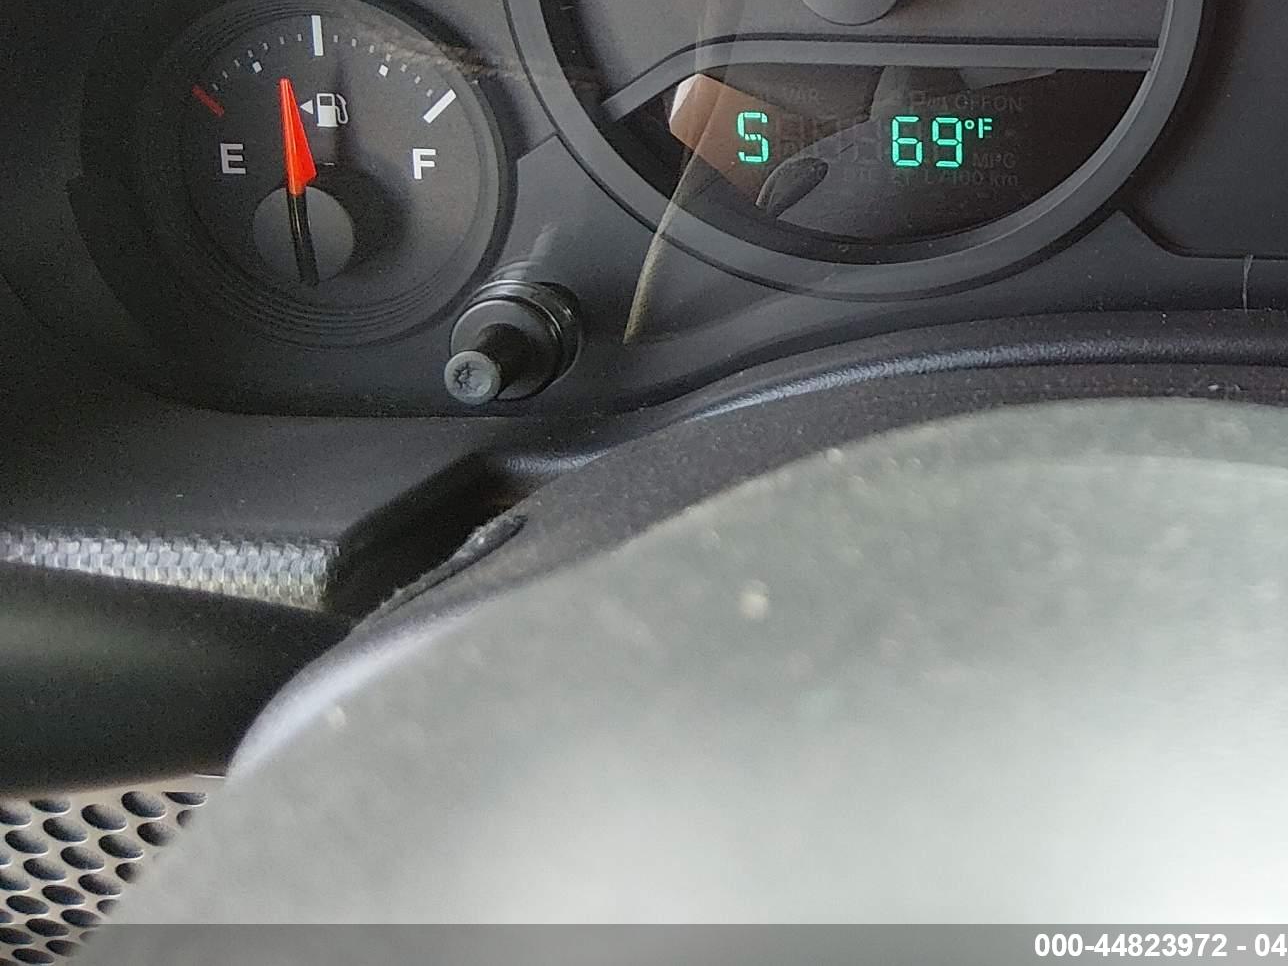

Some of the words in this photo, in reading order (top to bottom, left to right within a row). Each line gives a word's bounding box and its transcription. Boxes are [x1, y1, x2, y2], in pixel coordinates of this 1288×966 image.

[736, 111, 770, 165] S
[220, 143, 246, 175] E
[412, 148, 436, 180] F
